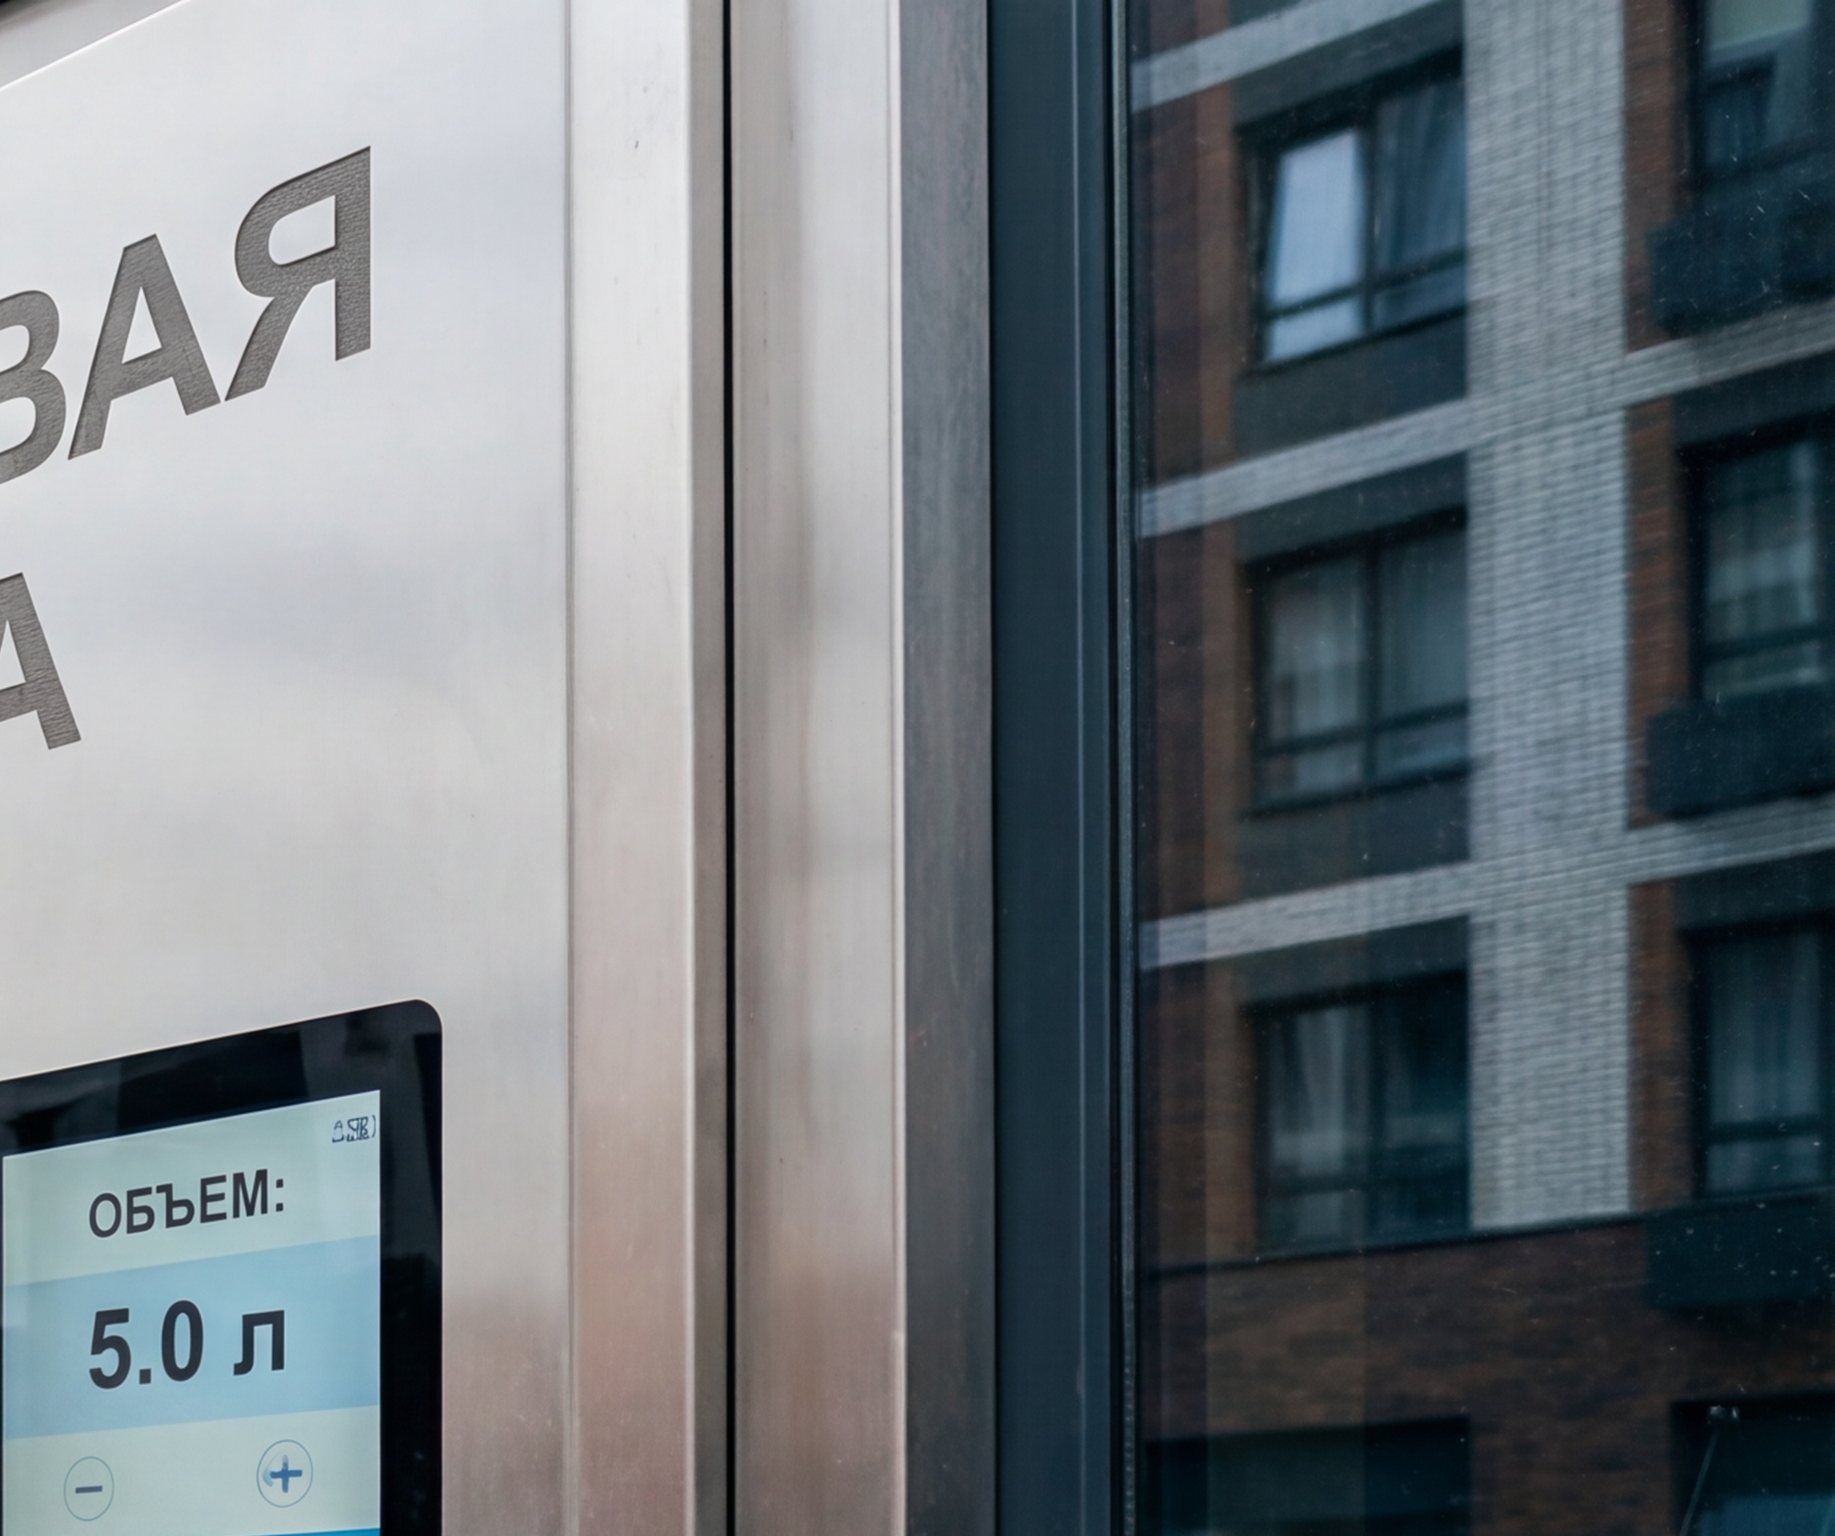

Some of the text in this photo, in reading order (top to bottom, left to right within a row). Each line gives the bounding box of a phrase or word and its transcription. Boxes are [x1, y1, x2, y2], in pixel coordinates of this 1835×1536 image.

[89, 1168, 284, 1238] ОБЪЕМ:
[89, 1300, 285, 1390] 5.0 л
